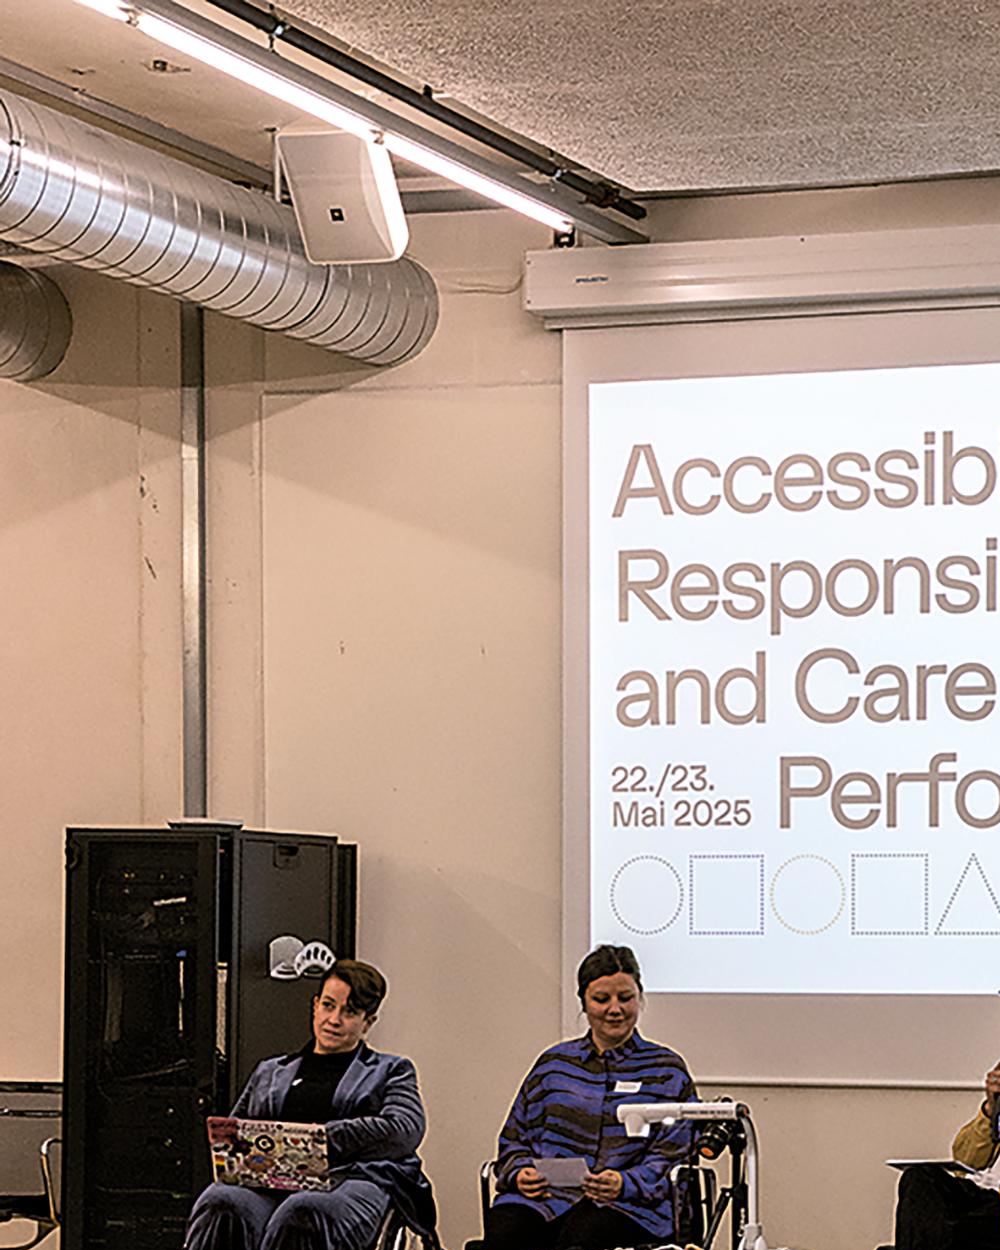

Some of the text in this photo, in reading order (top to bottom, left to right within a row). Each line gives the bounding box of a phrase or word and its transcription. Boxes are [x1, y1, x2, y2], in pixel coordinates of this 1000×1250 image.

[616, 651, 766, 727] and
[795, 648, 996, 724] Care
[612, 763, 714, 798] 22./23.
[613, 800, 751, 827] Mai 2025
